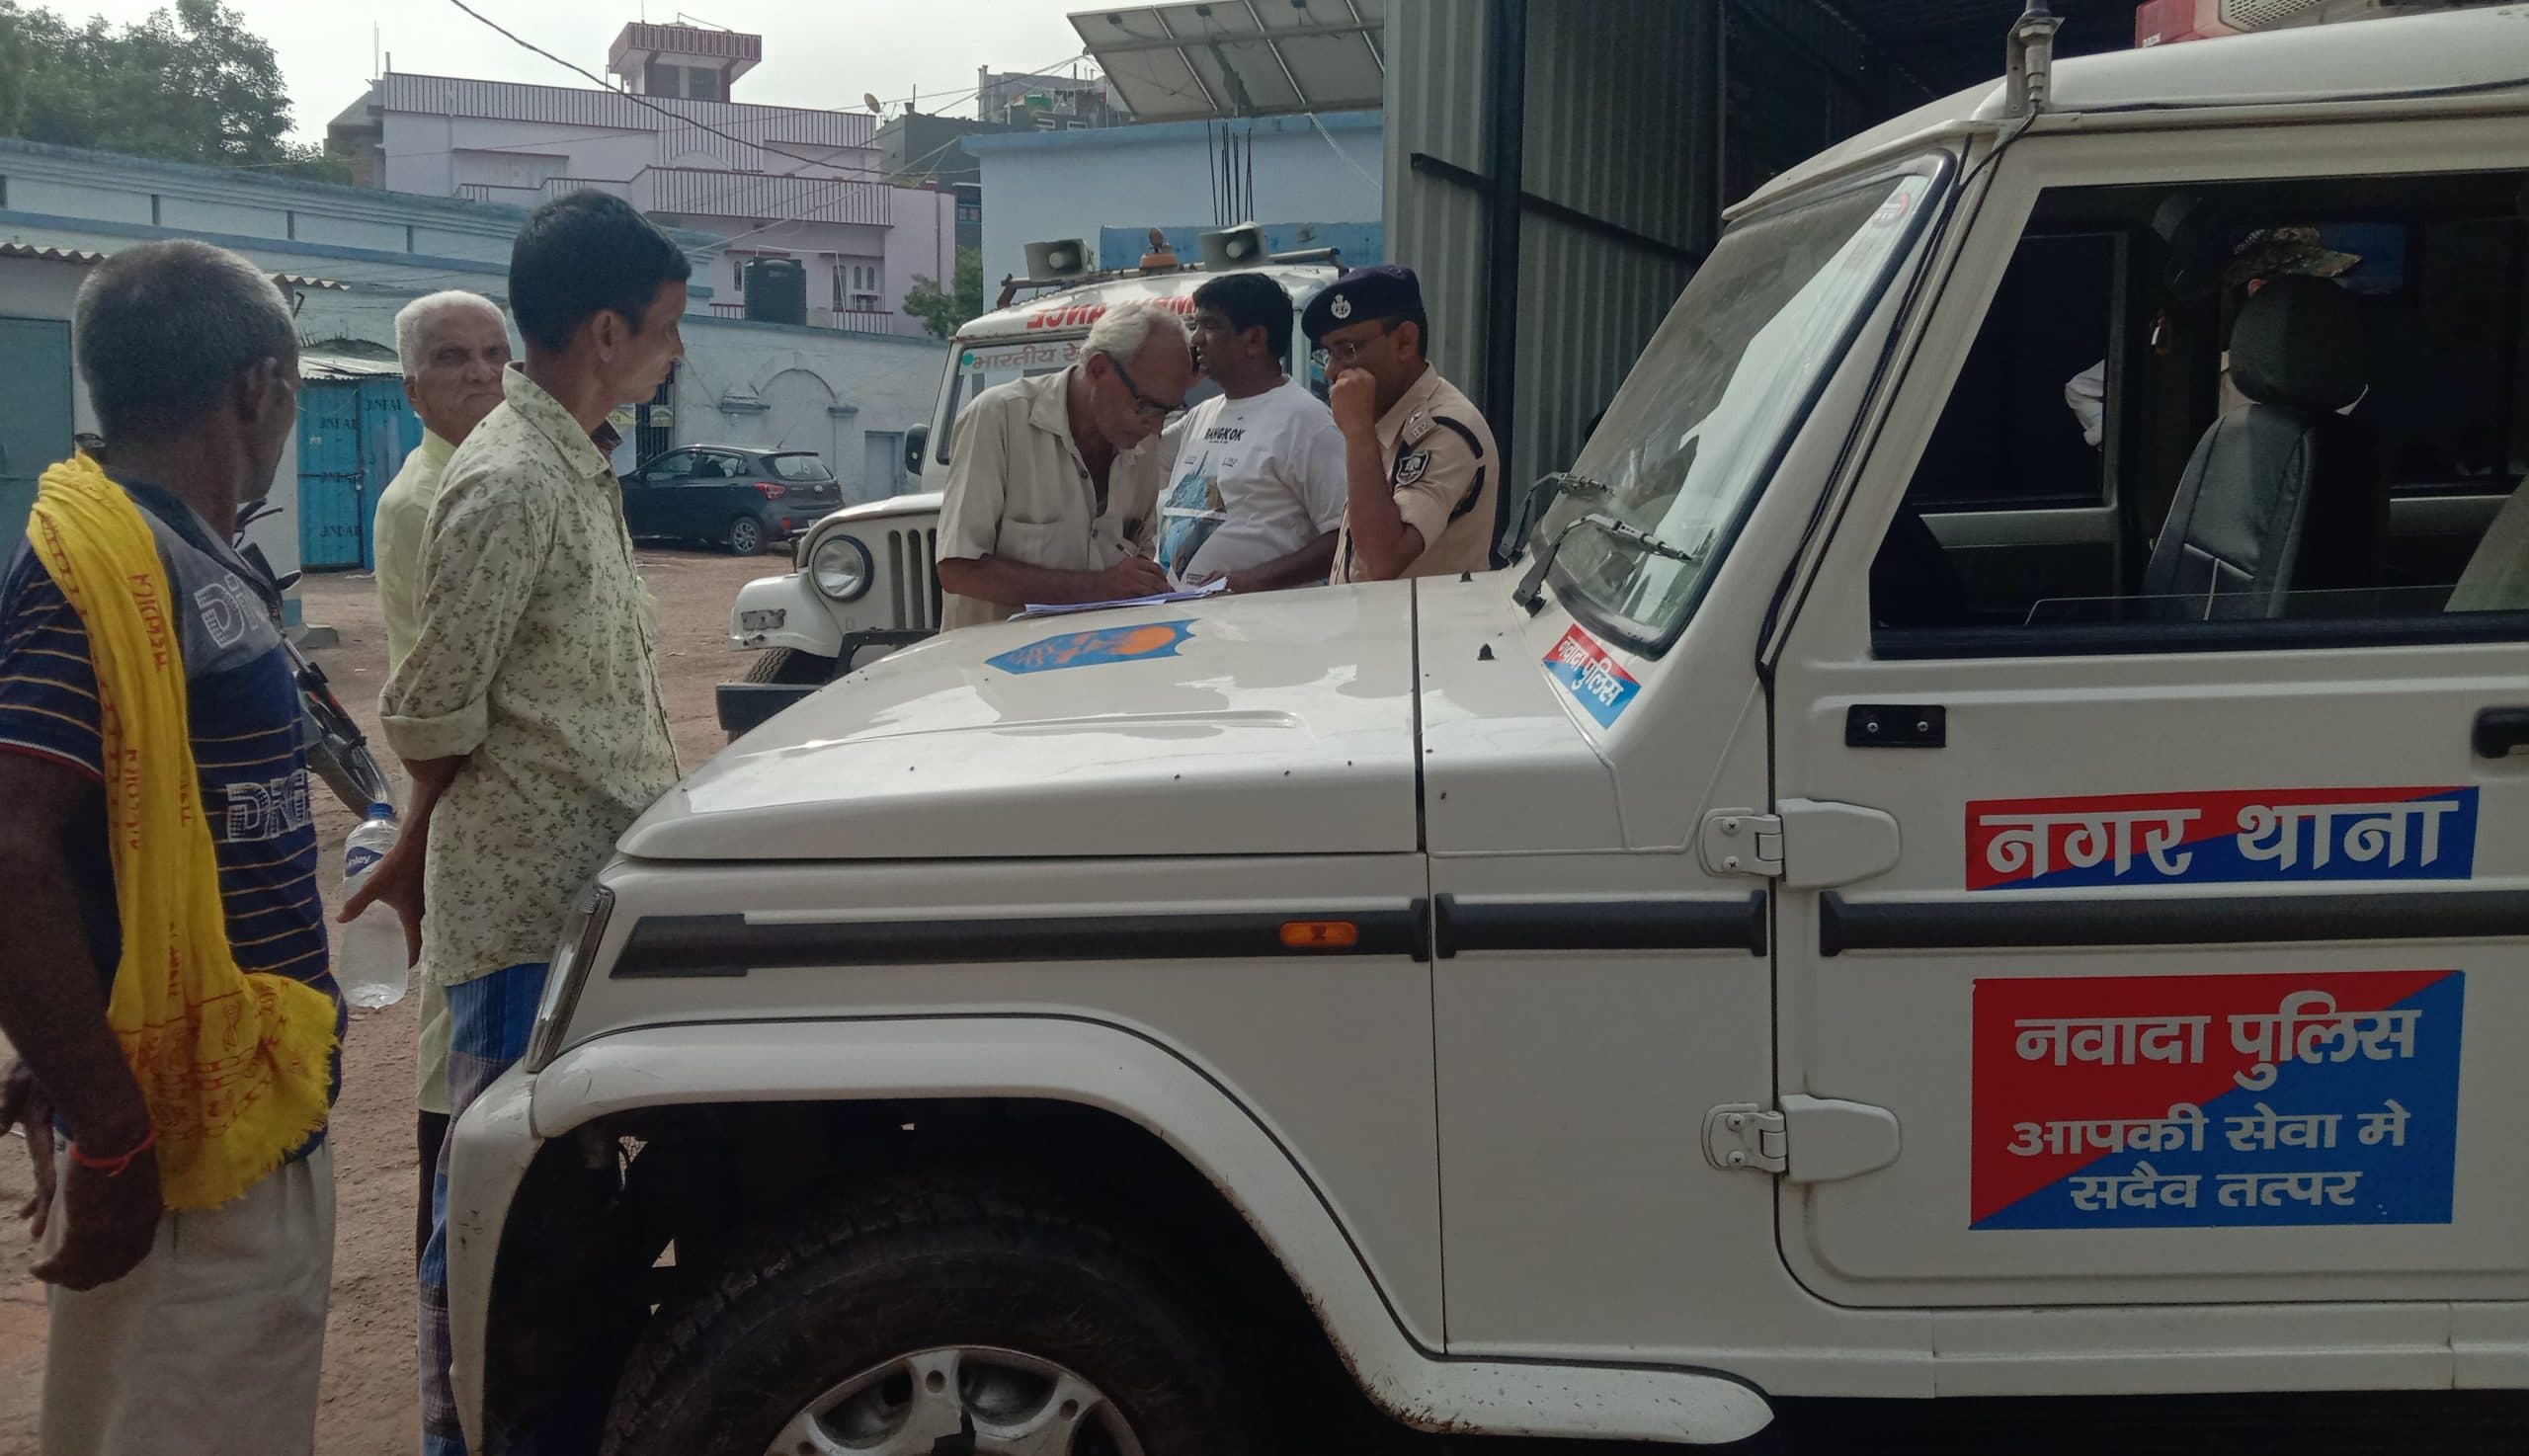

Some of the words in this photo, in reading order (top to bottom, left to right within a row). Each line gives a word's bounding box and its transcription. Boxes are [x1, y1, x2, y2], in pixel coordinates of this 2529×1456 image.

[972, 346, 1056, 369] भारतीय
[1572, 657, 1624, 706] पुलिस
[1980, 808, 2201, 879] नगर
[2237, 800, 2459, 871] थाना
[2015, 1015, 2211, 1067] नवादा
[2228, 991, 2422, 1092] पुलिस
[2007, 1103, 2209, 1157] आपकी
[2224, 1102, 2342, 1152] सेवा
[2357, 1098, 2410, 1147] मे
[2069, 1160, 2202, 1211] सदैव
[2216, 1171, 2362, 1207] तत्पर
